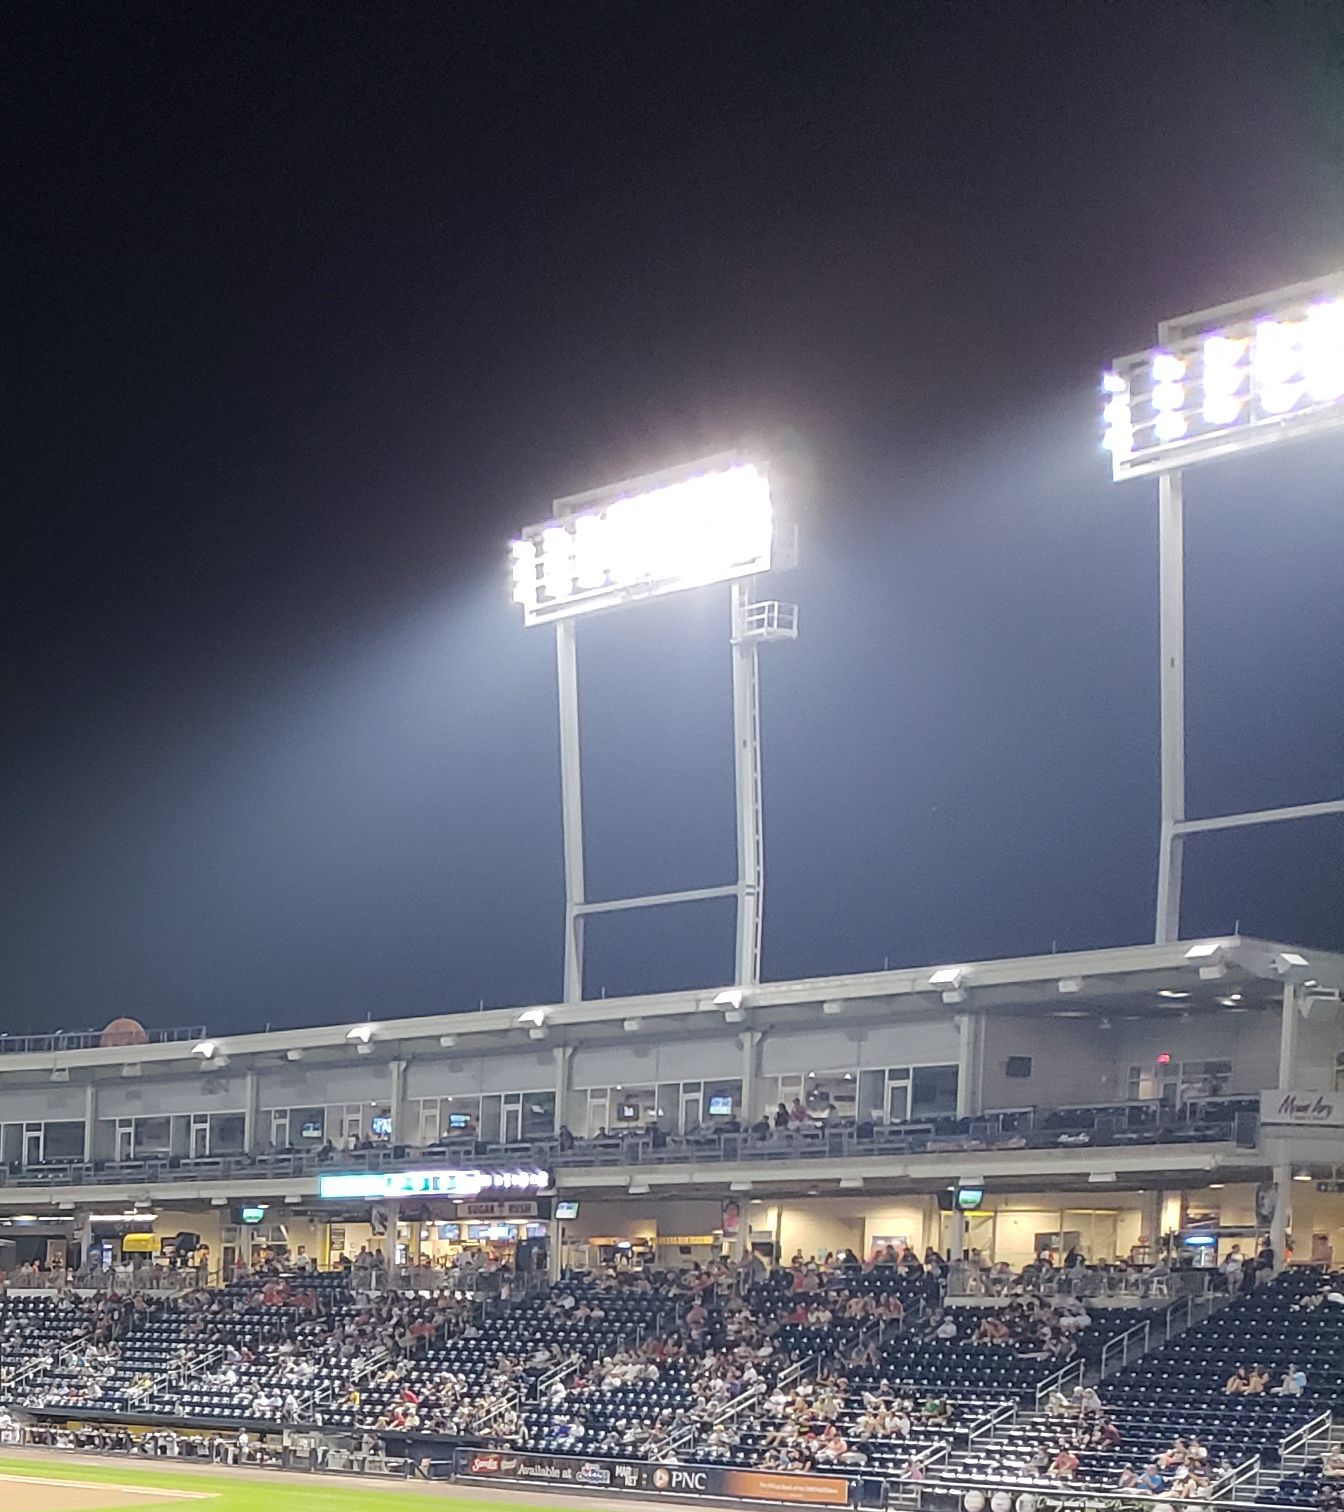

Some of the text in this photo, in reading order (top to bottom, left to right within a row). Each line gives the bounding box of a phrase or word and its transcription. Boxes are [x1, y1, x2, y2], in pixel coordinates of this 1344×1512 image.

[467, 1203, 531, 1214] SUGAR RUSH
[517, 1464, 561, 1479] Available
[561, 1468, 572, 1479] at
[671, 1471, 707, 1490] PNC
